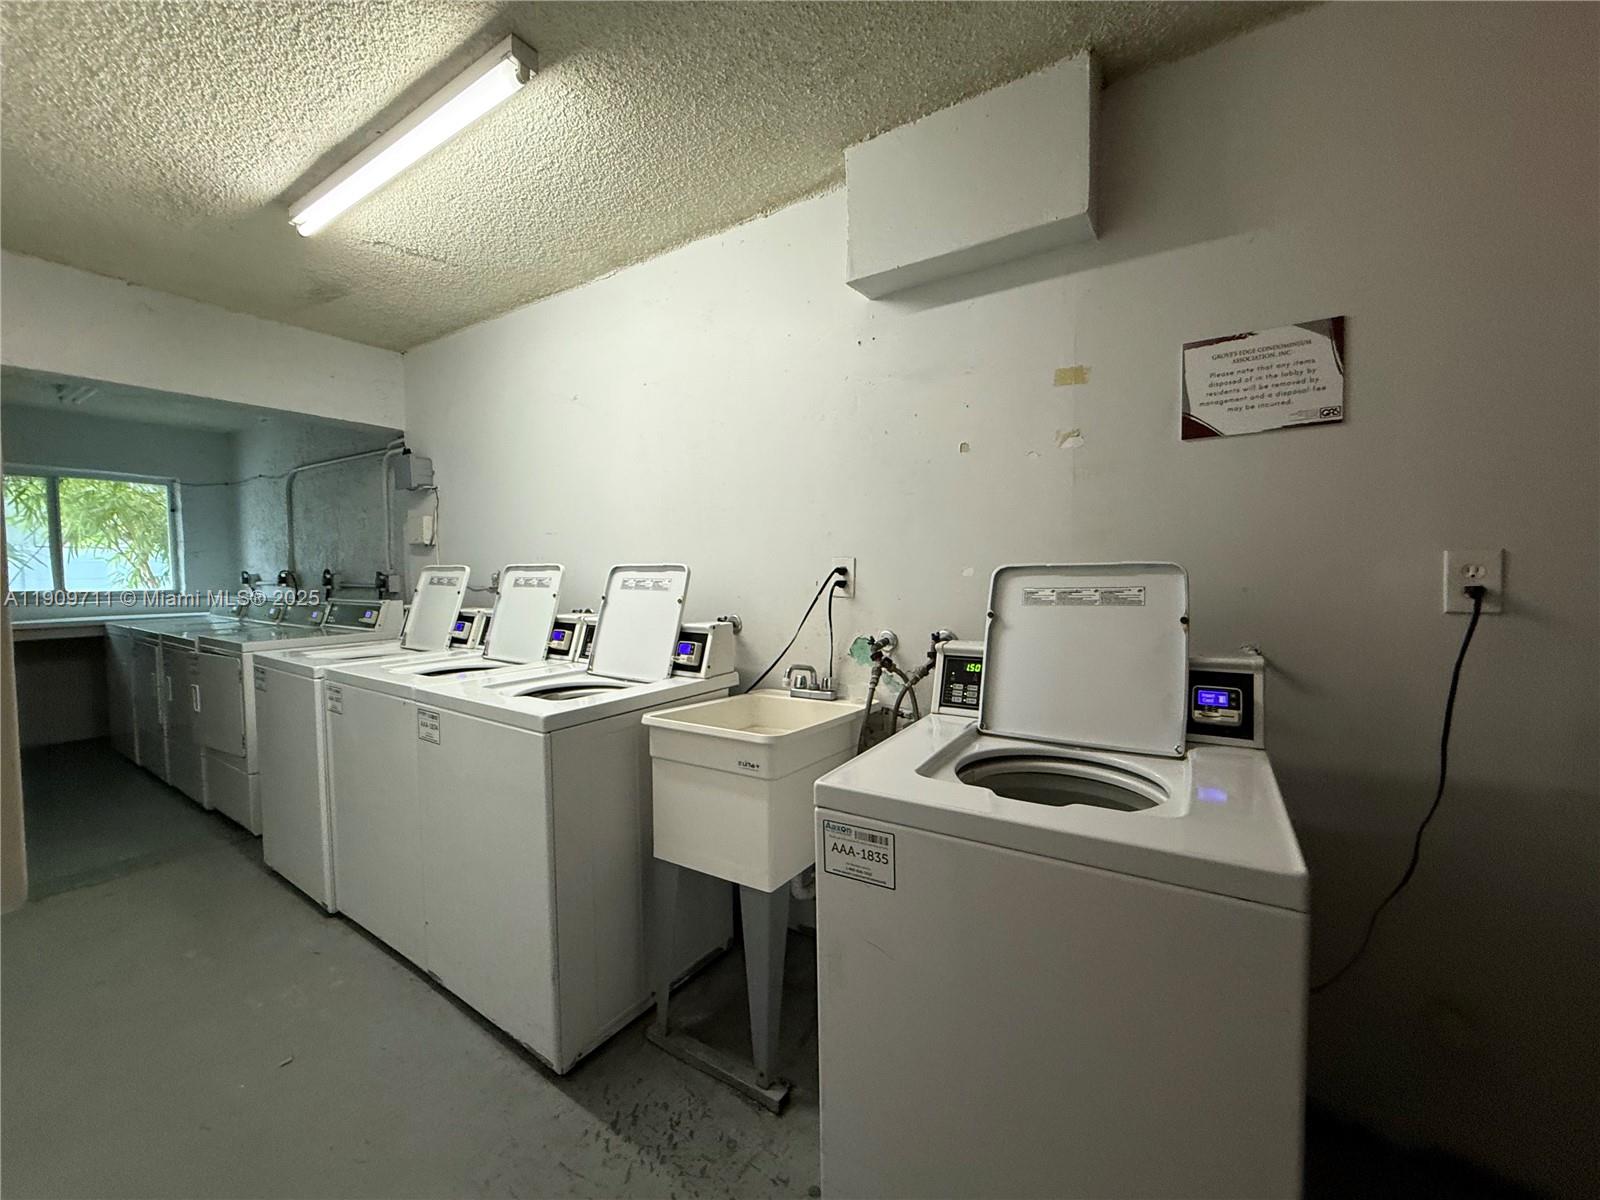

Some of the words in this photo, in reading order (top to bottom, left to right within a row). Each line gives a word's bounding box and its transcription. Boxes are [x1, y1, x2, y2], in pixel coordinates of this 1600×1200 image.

[1208, 377, 1242, 388] disposed
[1244, 375, 1254, 383] of
[1265, 372, 1279, 380] the
[1280, 367, 1304, 377] lobby
[1306, 366, 1318, 376] by
[1209, 370, 1235, 379] Please
[1236, 367, 1254, 375] note
[1256, 363, 1273, 371] that
[1275, 362, 1290, 370] any
[1292, 358, 1316, 367] items
[1199, 395, 1248, 407] management
[1249, 391, 1265, 401] and
[1275, 385, 1310, 398] disposal
[1312, 383, 1327, 392] fee
[1205, 387, 1240, 397] residents
[1258, 382, 1269, 390] be
[1271, 377, 1306, 388] removed
[1309, 374, 1320, 384] by
[1227, 405, 1244, 413] may
[831, 841, 889, 865] AAA-1835
